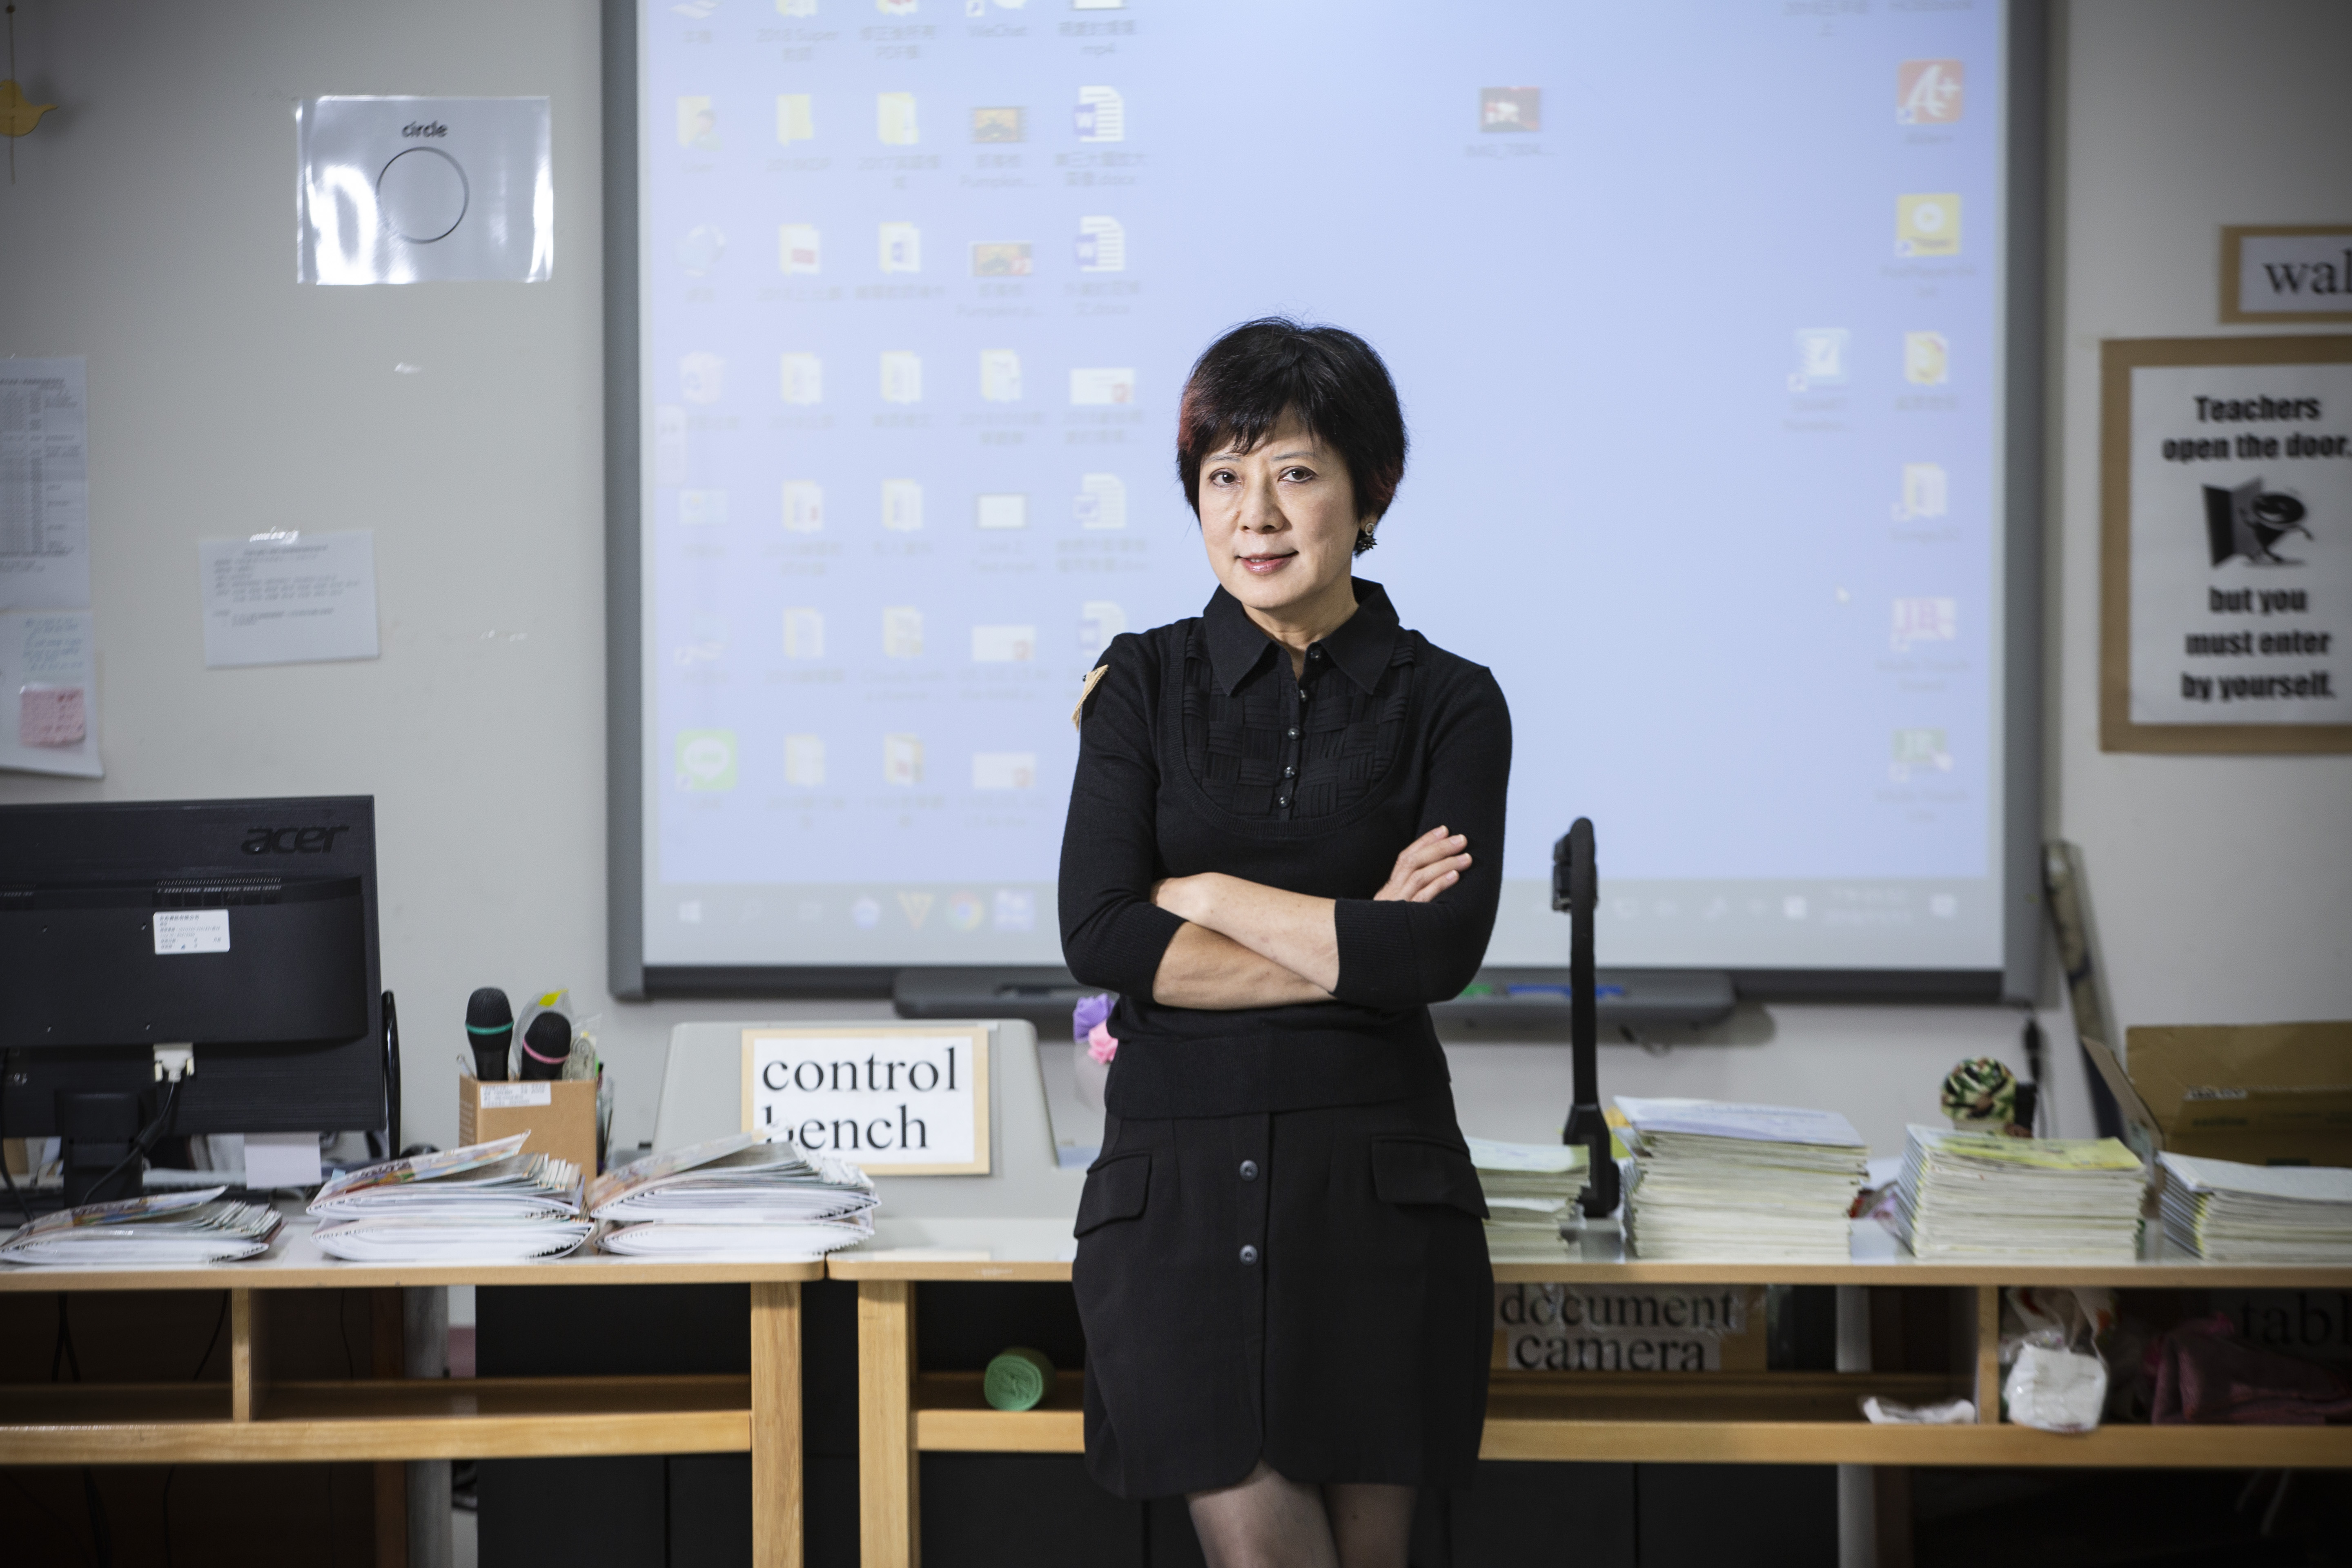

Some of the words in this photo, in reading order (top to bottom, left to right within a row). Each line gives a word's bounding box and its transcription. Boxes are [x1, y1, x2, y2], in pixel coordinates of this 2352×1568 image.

[401, 120, 448, 137] circle
[2194, 396, 2321, 422] Teachers
[2163, 438, 2230, 463] open
[2235, 433, 2279, 459] the
[2209, 587, 2251, 612] but
[2258, 589, 2308, 616] you
[2186, 631, 2252, 655] must
[2259, 631, 2330, 655] enter
[2182, 672, 2211, 702] by
[241, 826, 350, 854] acer
[762, 1046, 959, 1091] control
[1499, 1283, 1734, 1326] document
[1515, 1335, 1705, 1370] camera
